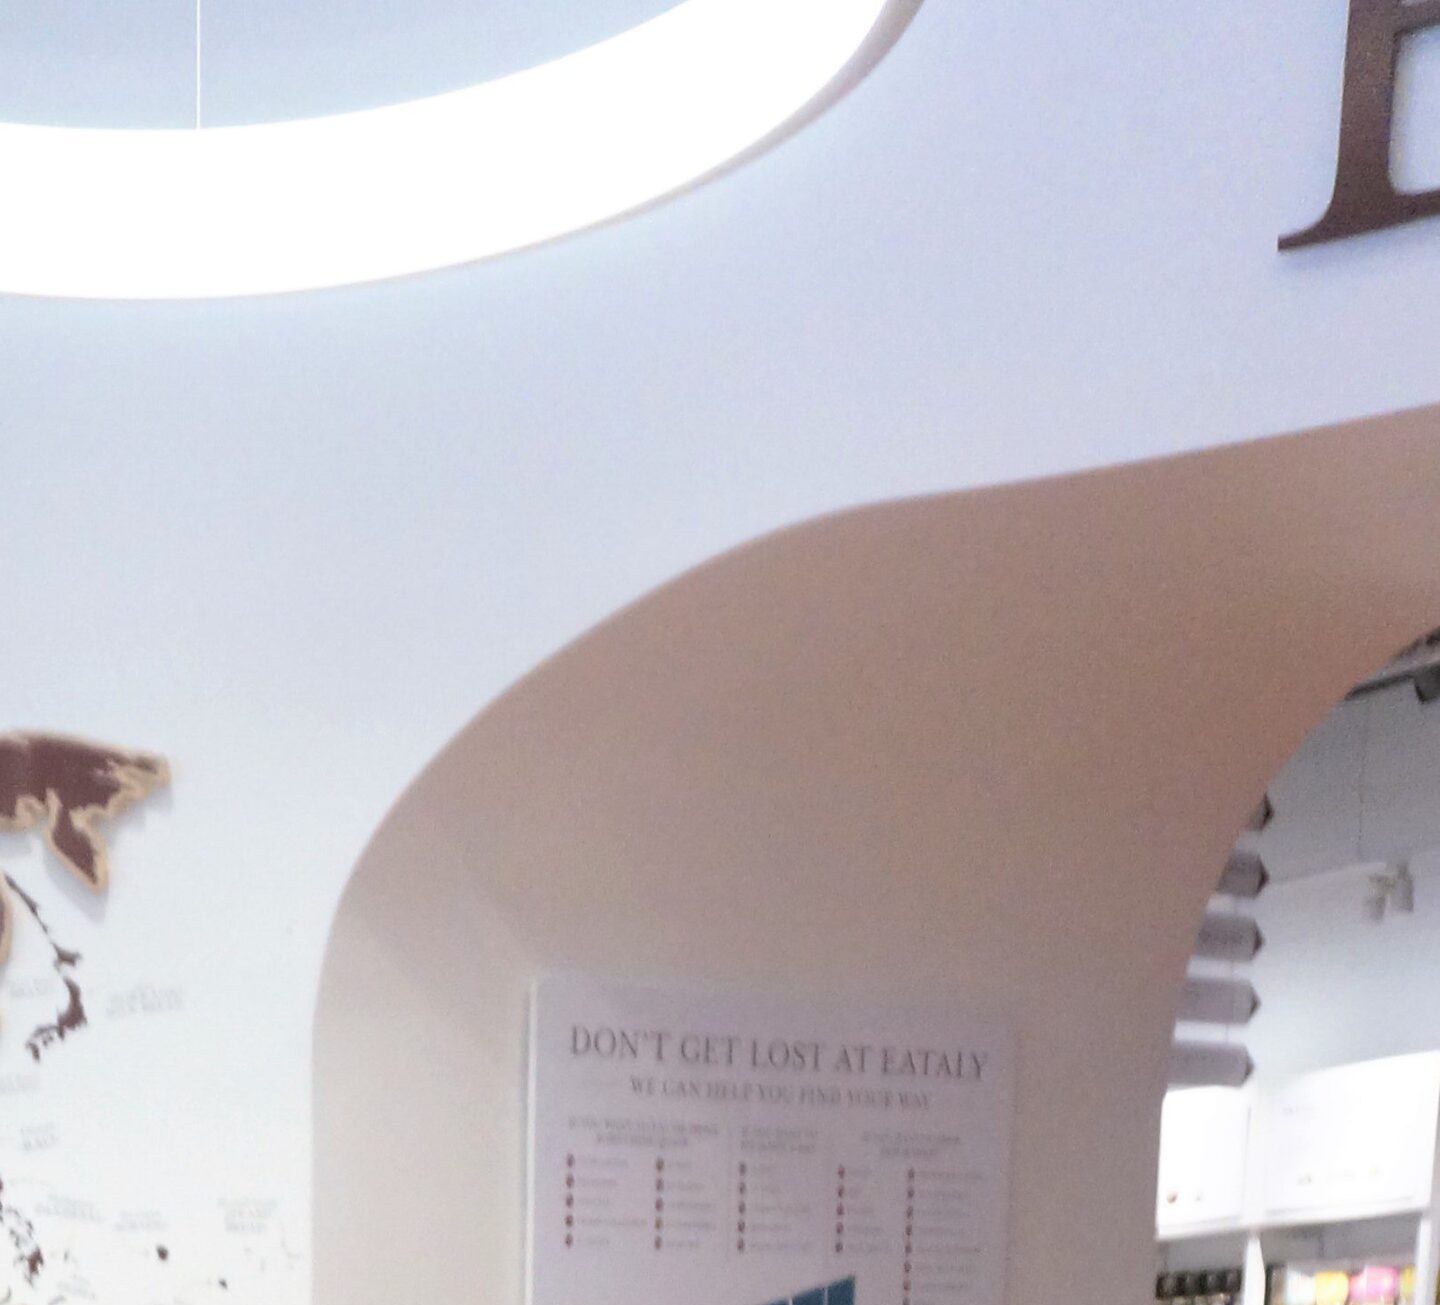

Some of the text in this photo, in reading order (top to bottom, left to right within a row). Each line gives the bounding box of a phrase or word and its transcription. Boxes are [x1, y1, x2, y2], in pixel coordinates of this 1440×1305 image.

[681, 1033, 743, 1067] GET
[750, 1038, 823, 1072] LOST
[834, 1043, 873, 1074] AT
[881, 1046, 989, 1081] EATALY
